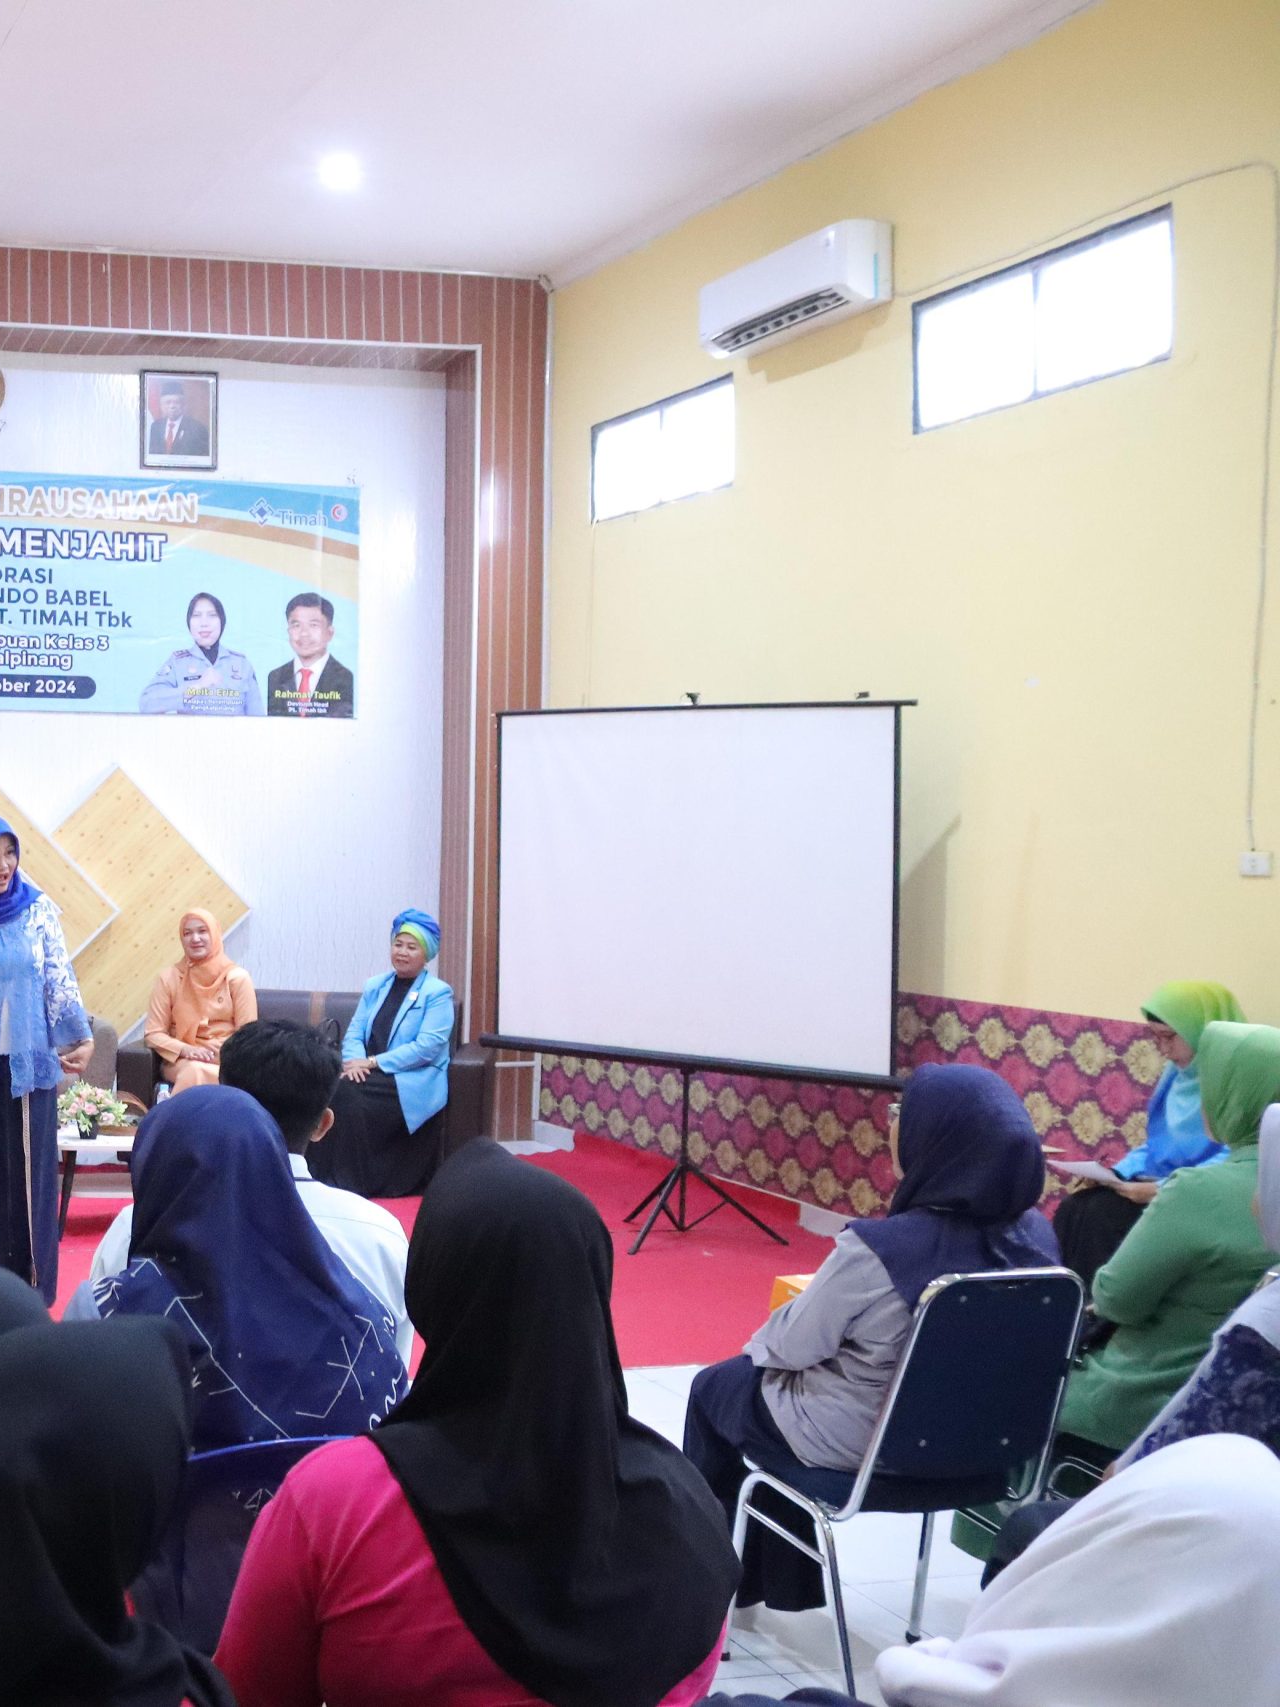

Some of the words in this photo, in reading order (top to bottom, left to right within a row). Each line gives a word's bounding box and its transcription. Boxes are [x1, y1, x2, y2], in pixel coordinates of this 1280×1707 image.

[278, 509, 327, 526] Timah
[45, 590, 113, 607] BABEL
[19, 609, 88, 627] TIMAH
[95, 611, 133, 628] Tbk
[45, 633, 94, 650] Kelas
[97, 635, 110, 651] 3
[35, 678, 77, 694] 2024
[274, 689, 311, 699] Rahmat
[313, 690, 341, 700] Taufik
